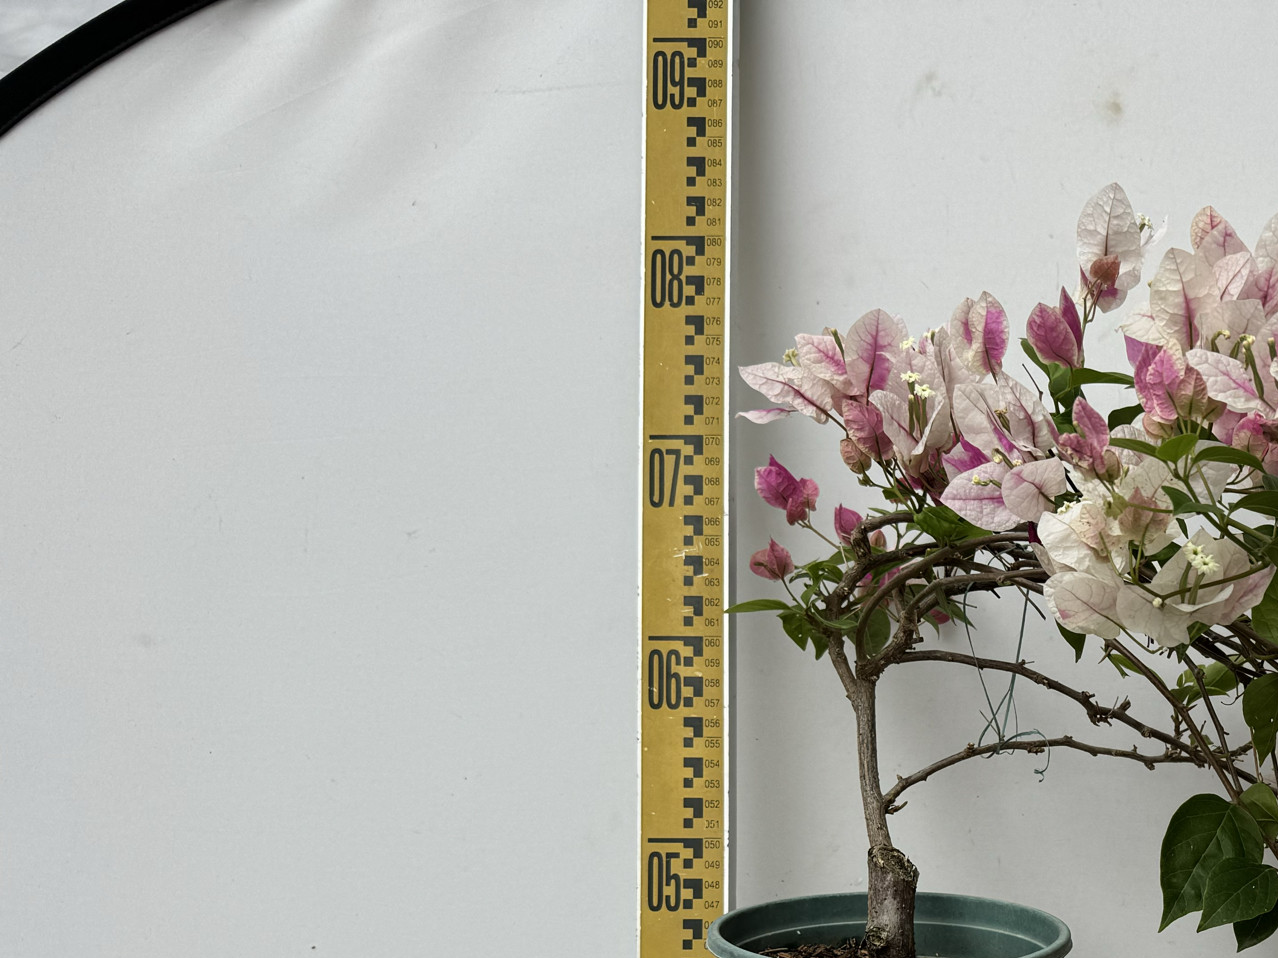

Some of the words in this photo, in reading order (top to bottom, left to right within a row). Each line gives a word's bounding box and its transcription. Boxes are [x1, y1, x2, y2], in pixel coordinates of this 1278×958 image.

[708, 0, 723, 9] 092
[708, 20, 723, 28] 091
[708, 40, 723, 48] 090
[707, 59, 723, 68] 089
[652, 51, 685, 110] 09
[707, 79, 723, 88] 088
[707, 99, 723, 107] 087
[707, 118, 722, 127] 086
[707, 139, 722, 147] 085
[707, 158, 722, 167] 084
[706, 178, 722, 187] 083
[706, 198, 722, 207] 082
[706, 218, 721, 226] 081
[706, 238, 721, 246] 080
[706, 257, 721, 266] 079
[651, 249, 683, 308] 08
[705, 277, 721, 286] 078
[705, 297, 721, 306] 077
[705, 317, 721, 325] 076
[705, 337, 721, 346] 075
[705, 357, 721, 365] 074
[705, 377, 721, 385] 073
[705, 397, 721, 405] 072
[704, 417, 720, 425] 071
[704, 437, 720, 446] 070
[704, 457, 720, 466] 069
[649, 448, 681, 508] 07
[704, 477, 720, 486] 068
[704, 497, 720, 506] 067
[704, 517, 720, 526] 066
[705, 538, 720, 546] 065
[705, 557, 720, 566] 064
[705, 578, 720, 586] 063
[705, 598, 720, 606] 062
[705, 618, 720, 627] 061
[705, 639, 720, 647] 060
[705, 659, 720, 667] 059
[648, 649, 682, 710] 06
[705, 679, 720, 687] 058
[705, 699, 720, 707] 057
[705, 719, 720, 728] 056
[705, 739, 720, 748] 055
[705, 759, 720, 768] 054
[705, 779, 720, 788] 053
[705, 800, 720, 808] 052
[705, 840, 720, 849] 050
[704, 860, 720, 869] 049
[647, 851, 681, 912] 05
[704, 881, 720, 889] 048
[704, 901, 720, 909] 047
